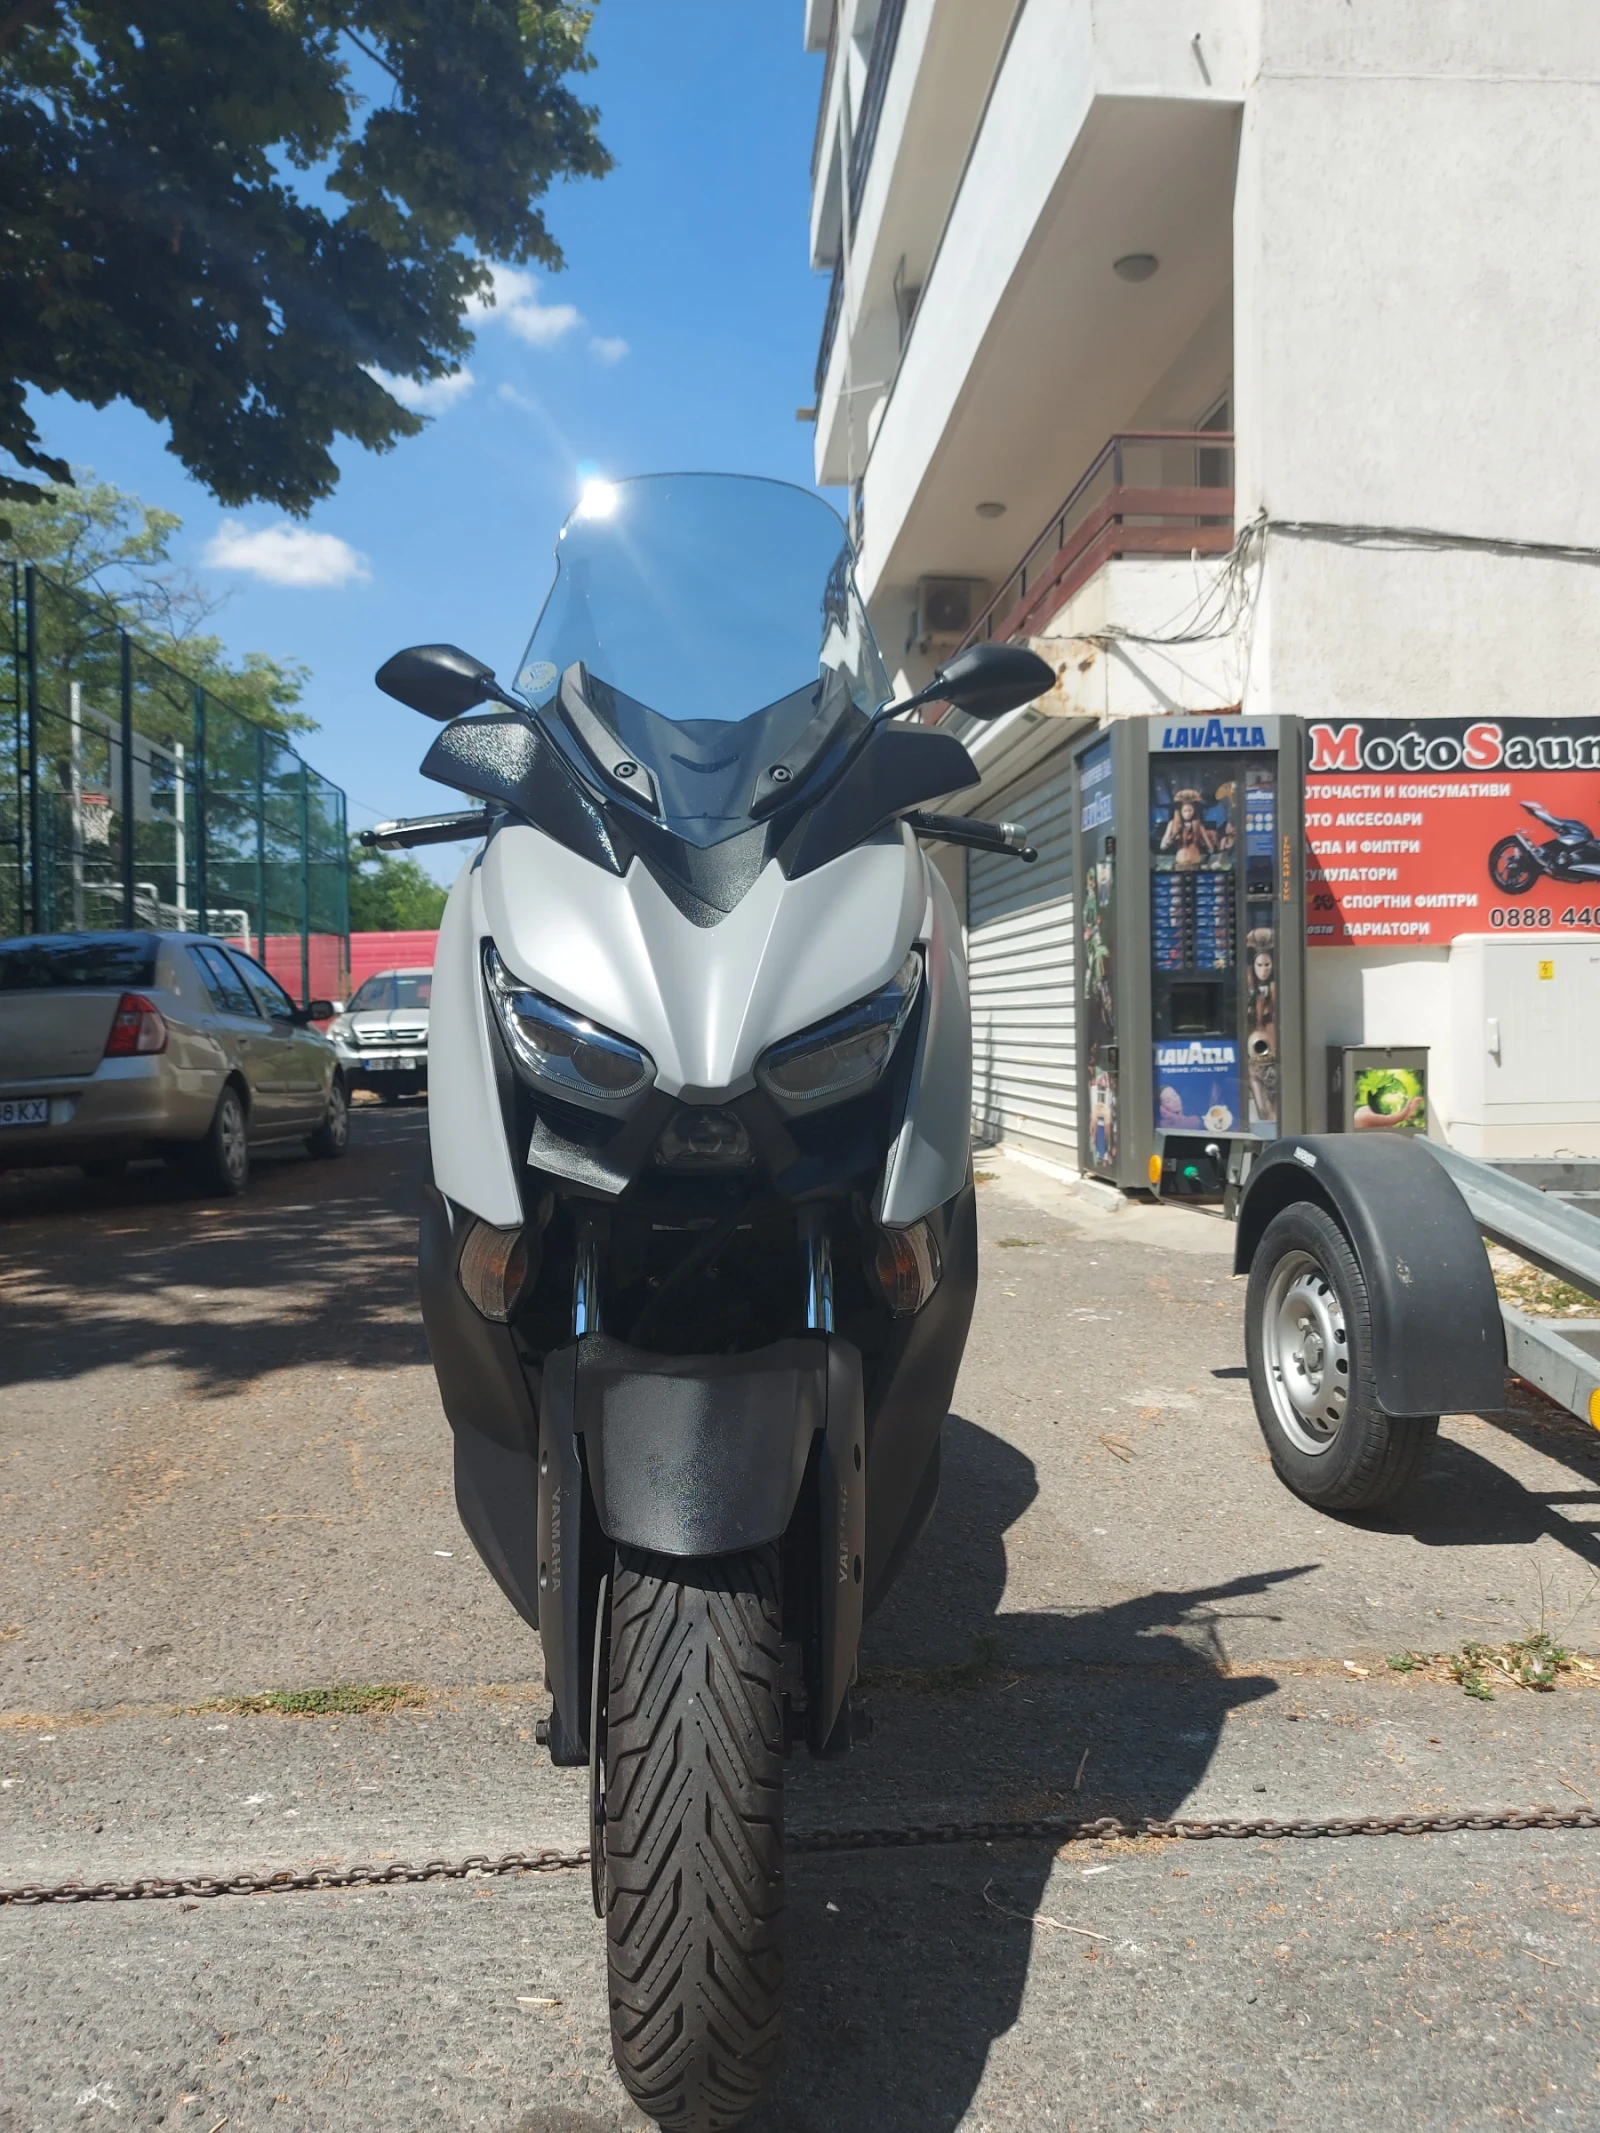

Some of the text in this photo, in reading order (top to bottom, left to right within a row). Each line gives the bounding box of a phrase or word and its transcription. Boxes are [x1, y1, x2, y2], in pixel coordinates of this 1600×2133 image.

[1162, 719, 1266, 748] LAVAZZA
[1309, 723, 1600, 771] MotoSaun
[1384, 785, 1396, 798] И
[1398, 783, 1511, 798] КОНСУМАТИВИ
[1335, 812, 1423, 827] АКСЕСОАРИ
[1345, 840, 1357, 853] И
[1360, 839, 1421, 853] ФИЛТРИ
[1342, 893, 1479, 908] СПОРТНИ ФИЛТРИ
[1489, 907, 1552, 929] 0888
[1343, 922, 1431, 936] ВАРИАТОРИ
[1156, 1041, 1236, 1065] LAVAZZA
[551, 1485, 561, 1593] YAMAHA
